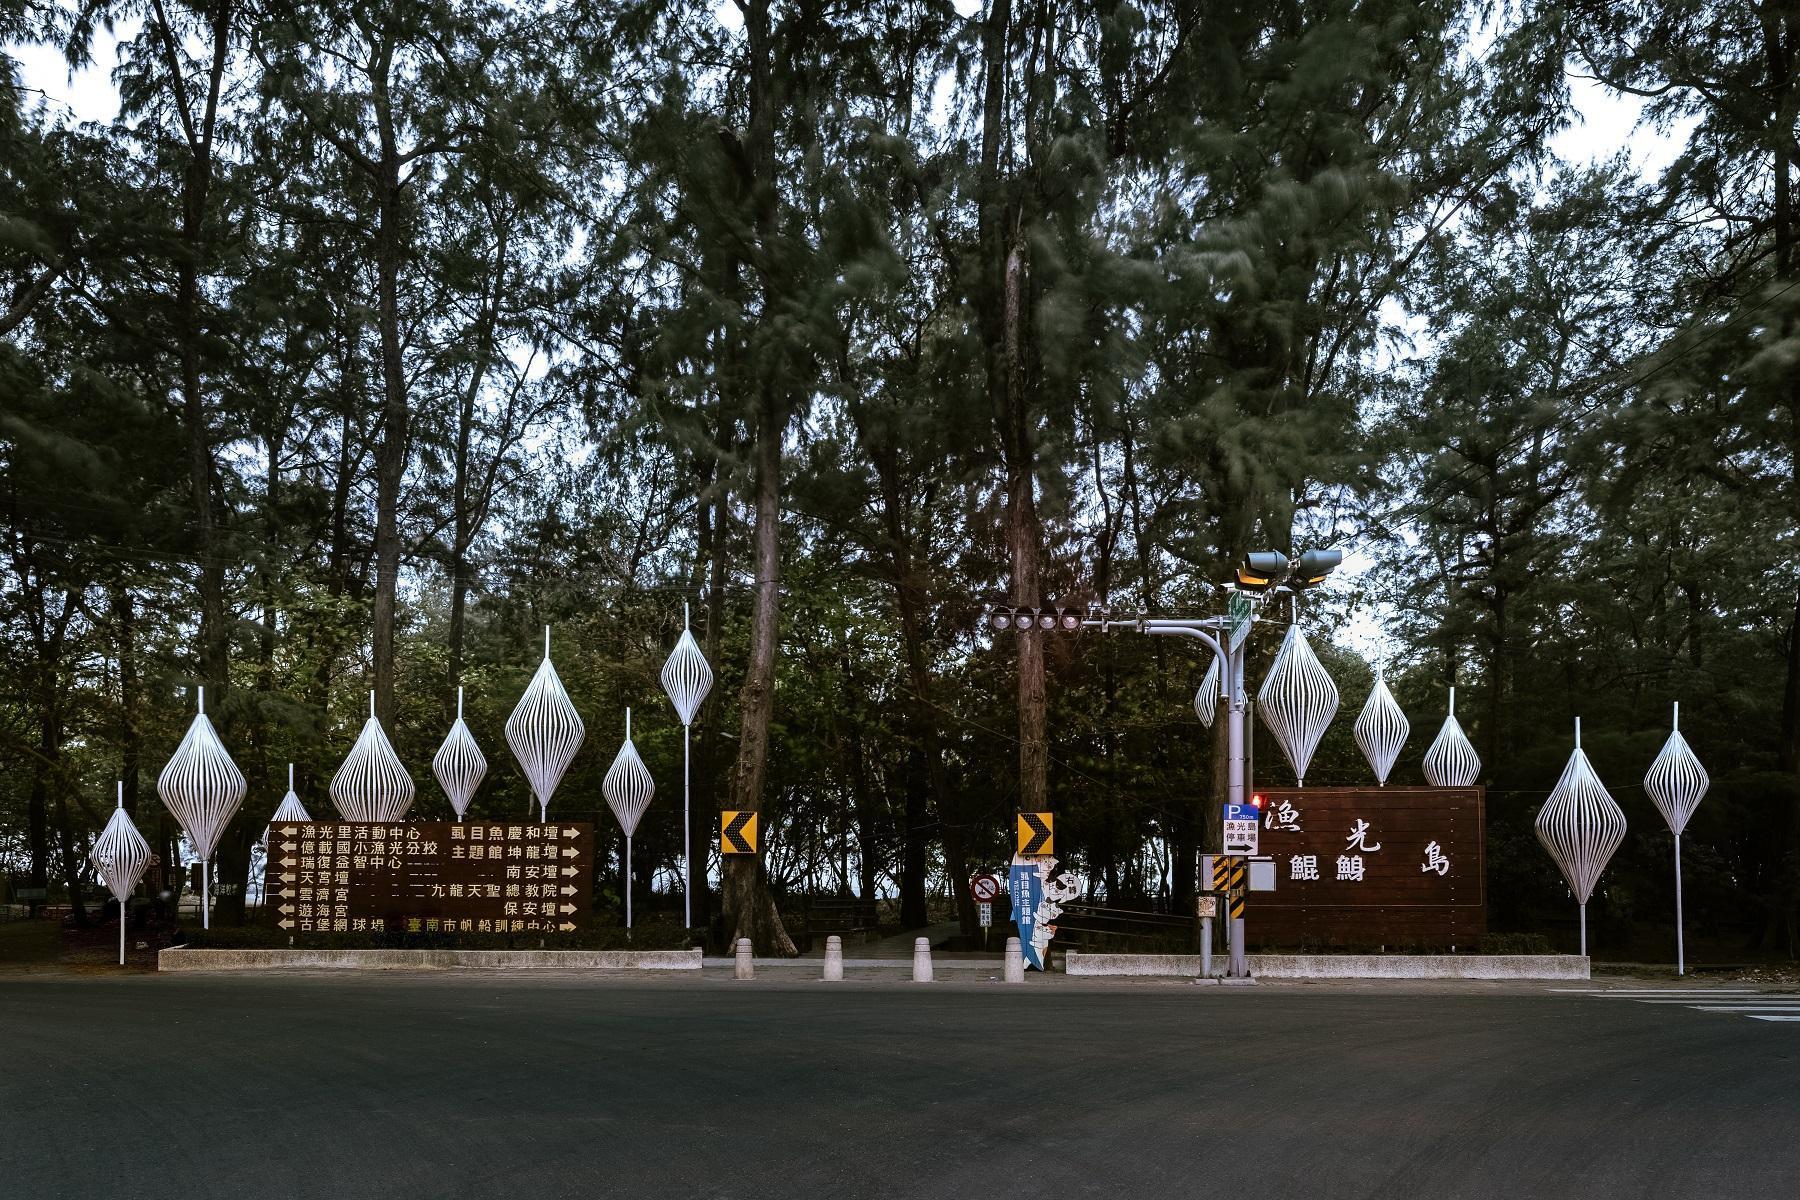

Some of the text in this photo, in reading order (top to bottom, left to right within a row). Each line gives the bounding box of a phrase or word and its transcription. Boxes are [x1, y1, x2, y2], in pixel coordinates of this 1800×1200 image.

[1228, 805, 1241, 820] P
[301, 825, 421, 840] 漁光里活動中心
[507, 826, 558, 840] 慶和壇
[1226, 821, 1257, 831] 漁光島
[451, 826, 504, 841] 虱目魚
[1226, 832, 1257, 843] 停車場
[300, 841, 438, 855] 億載國小漁光分校
[451, 845, 503, 860] 主題館
[300, 856, 402, 870] 瑞復益智中心
[300, 871, 349, 885] 天宮壇
[506, 865, 558, 879] 南安壇
[1020, 871, 1031, 925] 虱目魚主題館
[504, 902, 556, 917] 保安壇
[299, 918, 385, 932] 古堡網球場
